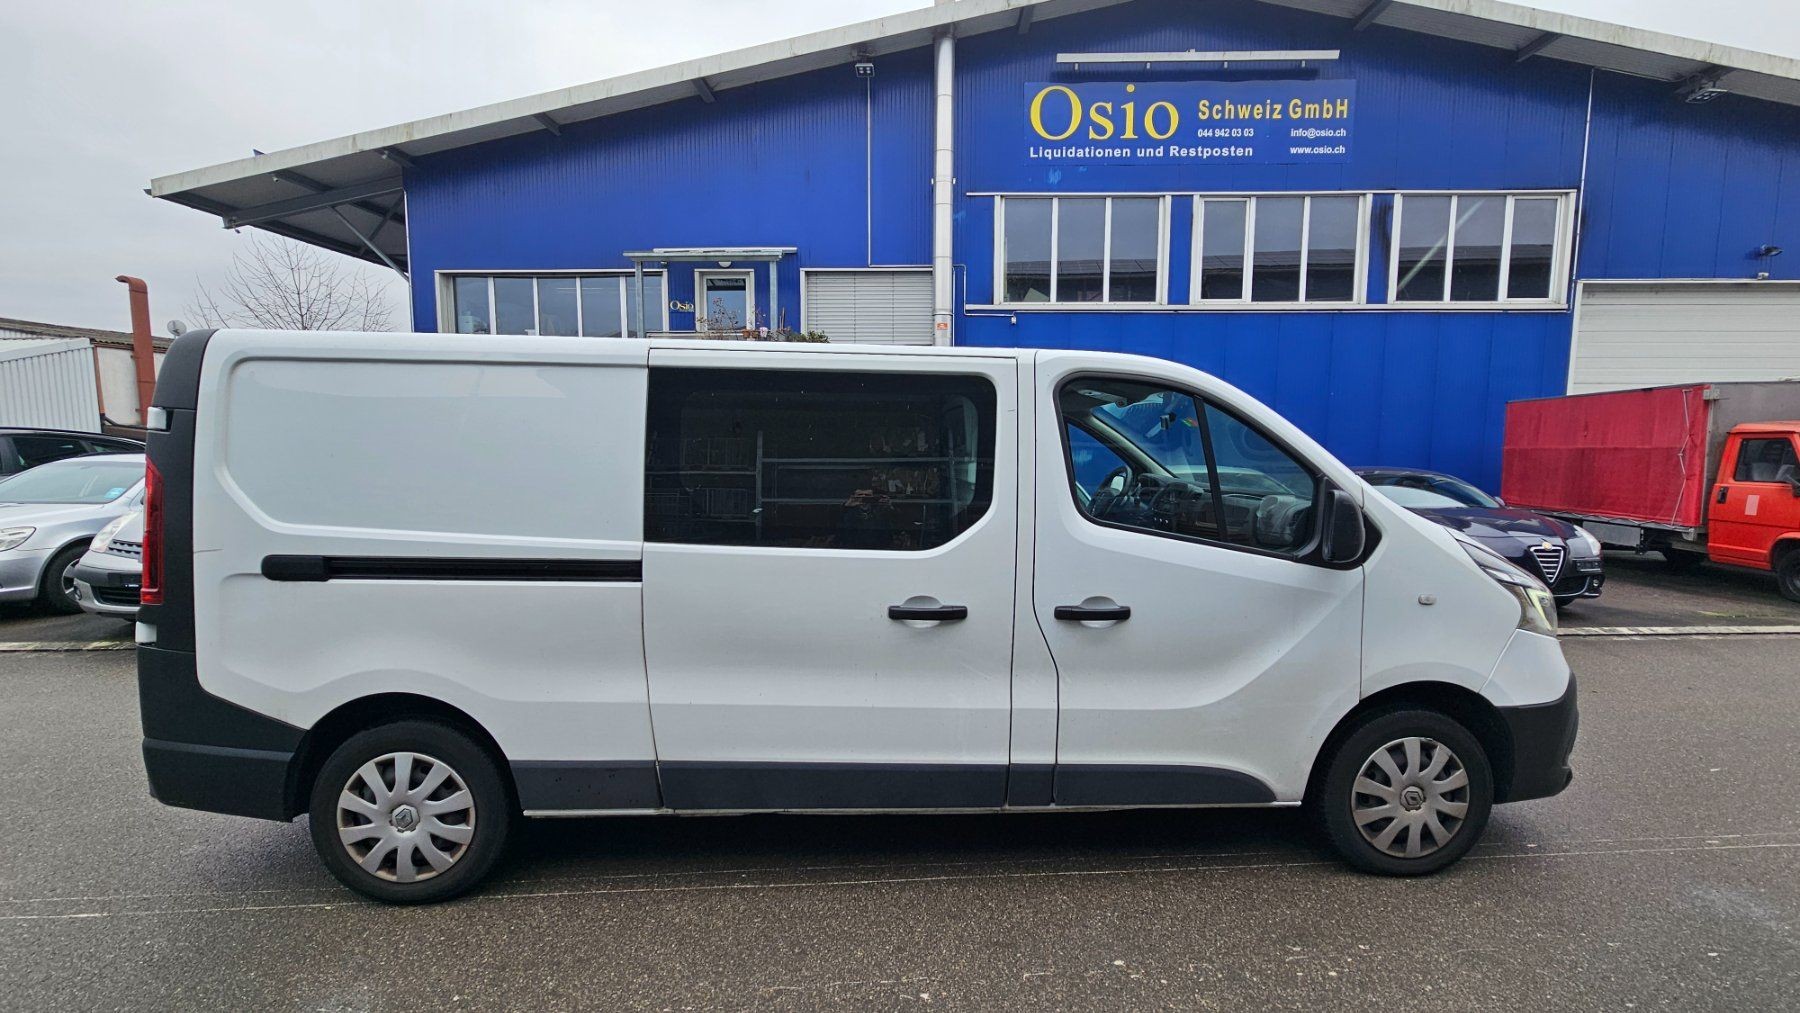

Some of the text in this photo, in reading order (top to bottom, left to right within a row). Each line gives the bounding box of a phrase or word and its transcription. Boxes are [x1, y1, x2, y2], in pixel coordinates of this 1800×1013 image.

[1030, 83, 1180, 141] Osio
[1198, 98, 1348, 120] Schweiz GmbH
[1197, 128, 1254, 138] 044 942 03 03
[1290, 128, 1347, 138] info@osio.ch
[1029, 145, 1253, 160] Liquidationen und Restposten
[1289, 145, 1346, 154] www.osio.ch
[669, 300, 694, 311] Osio
